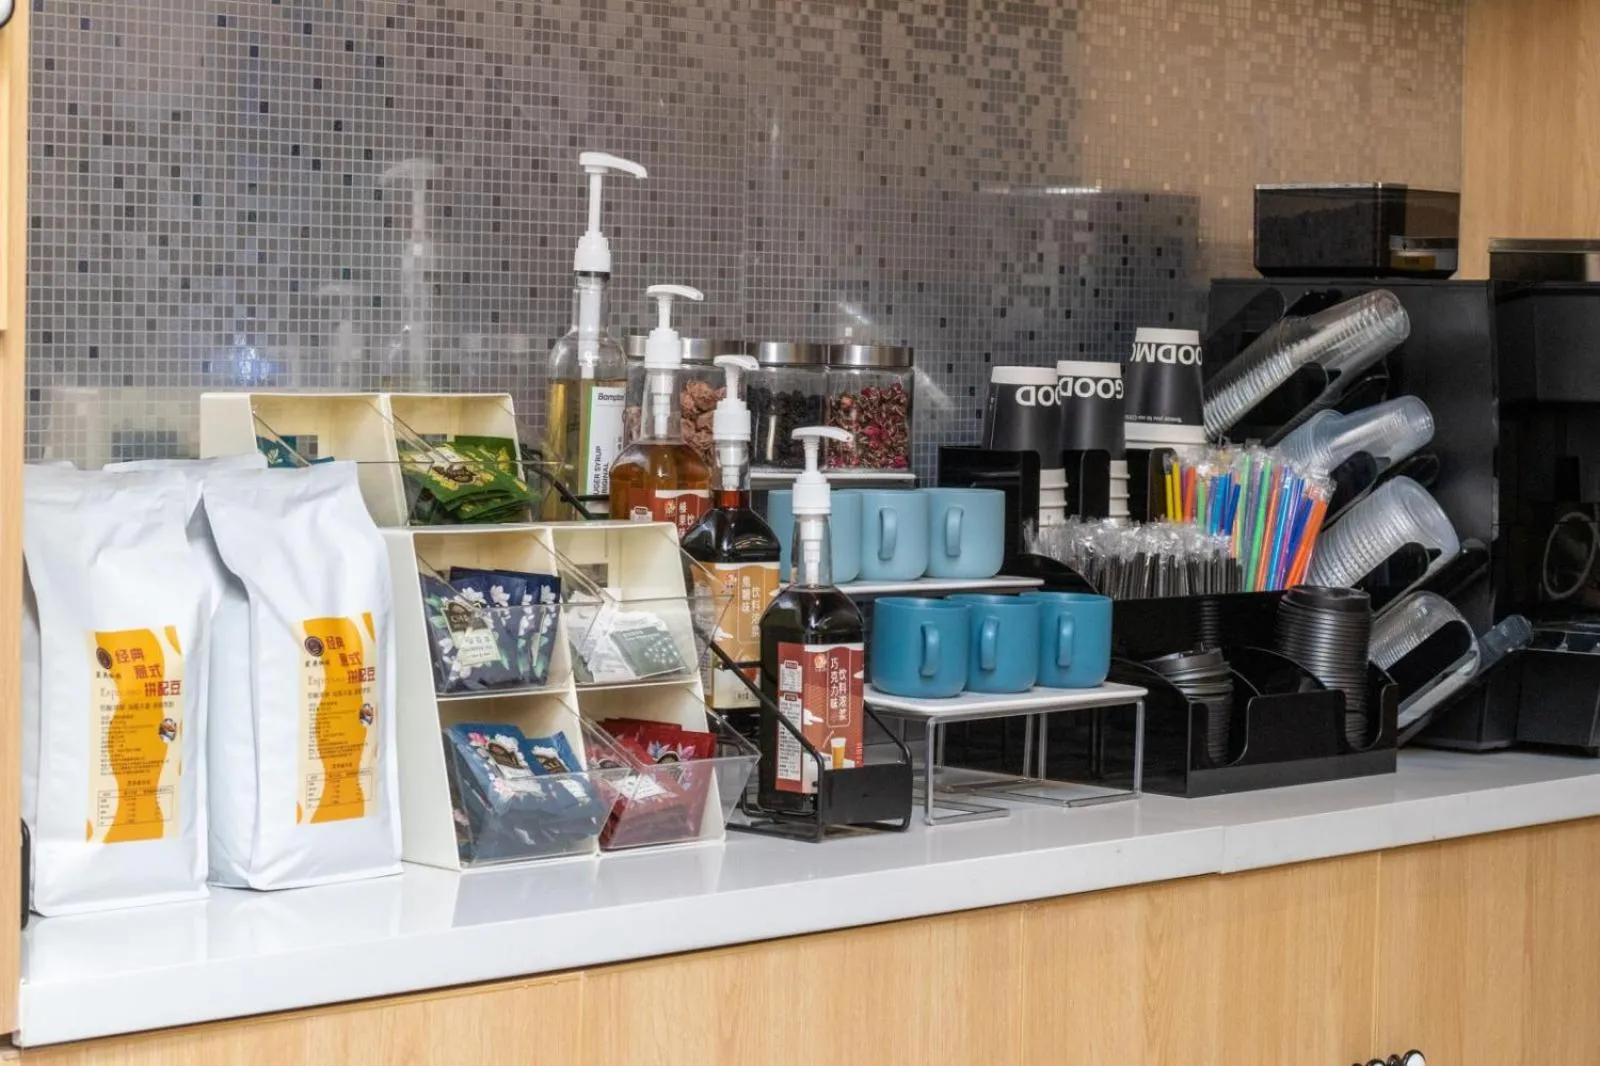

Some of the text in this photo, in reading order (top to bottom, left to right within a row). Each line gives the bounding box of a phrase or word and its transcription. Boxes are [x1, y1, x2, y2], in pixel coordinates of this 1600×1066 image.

[1059, 376, 1124, 400] GOOD
[115, 647, 145, 664] 经典
[132, 663, 163, 680] 意式
[144, 680, 182, 697] 拼配豆
[830, 657, 839, 709] 巧克力味
